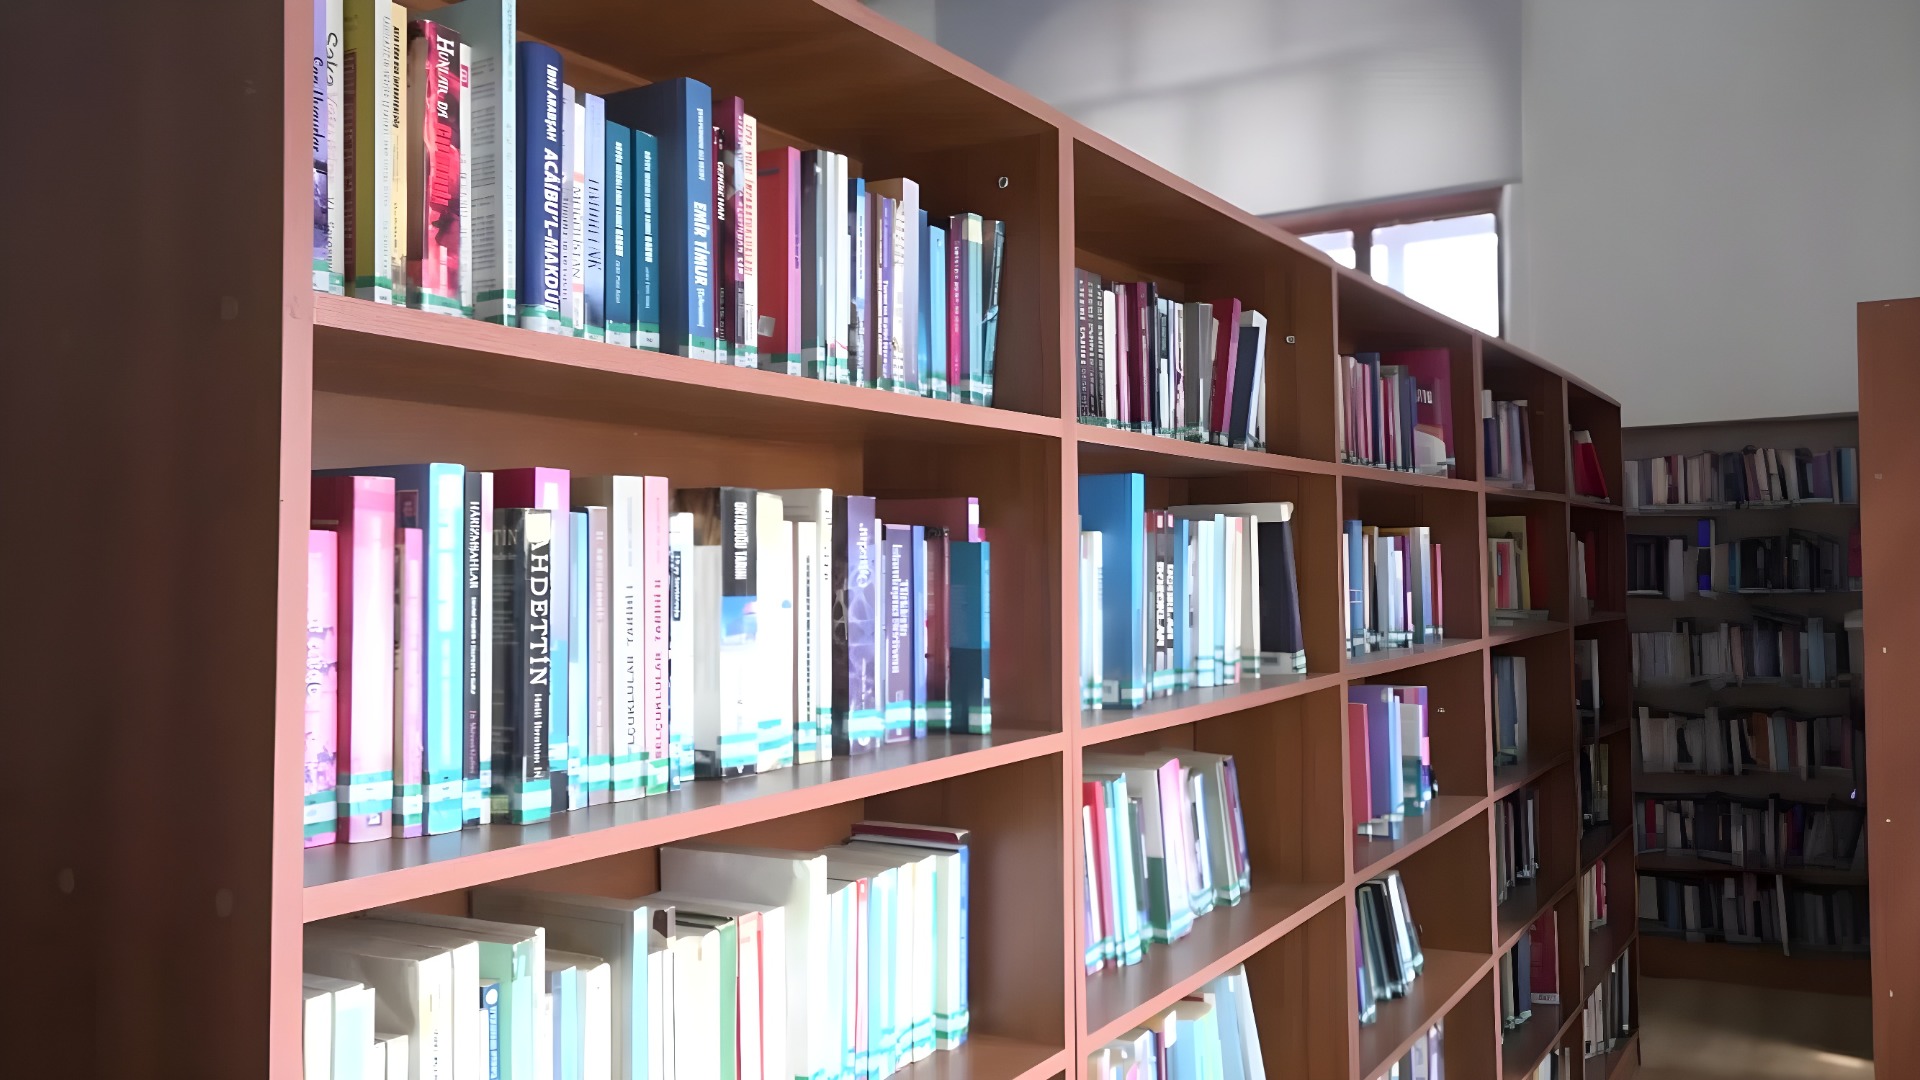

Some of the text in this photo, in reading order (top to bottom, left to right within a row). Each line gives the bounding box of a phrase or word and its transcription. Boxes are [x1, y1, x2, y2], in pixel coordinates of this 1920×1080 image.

[546, 64, 559, 90] İBNİ
[544, 90, 557, 142] ARABŞAH
[694, 201, 710, 237] EMİR
[695, 240, 710, 286] TİMUR
[734, 501, 749, 549] ORTADOĞU
[529, 540, 551, 685] AHDETTİN
